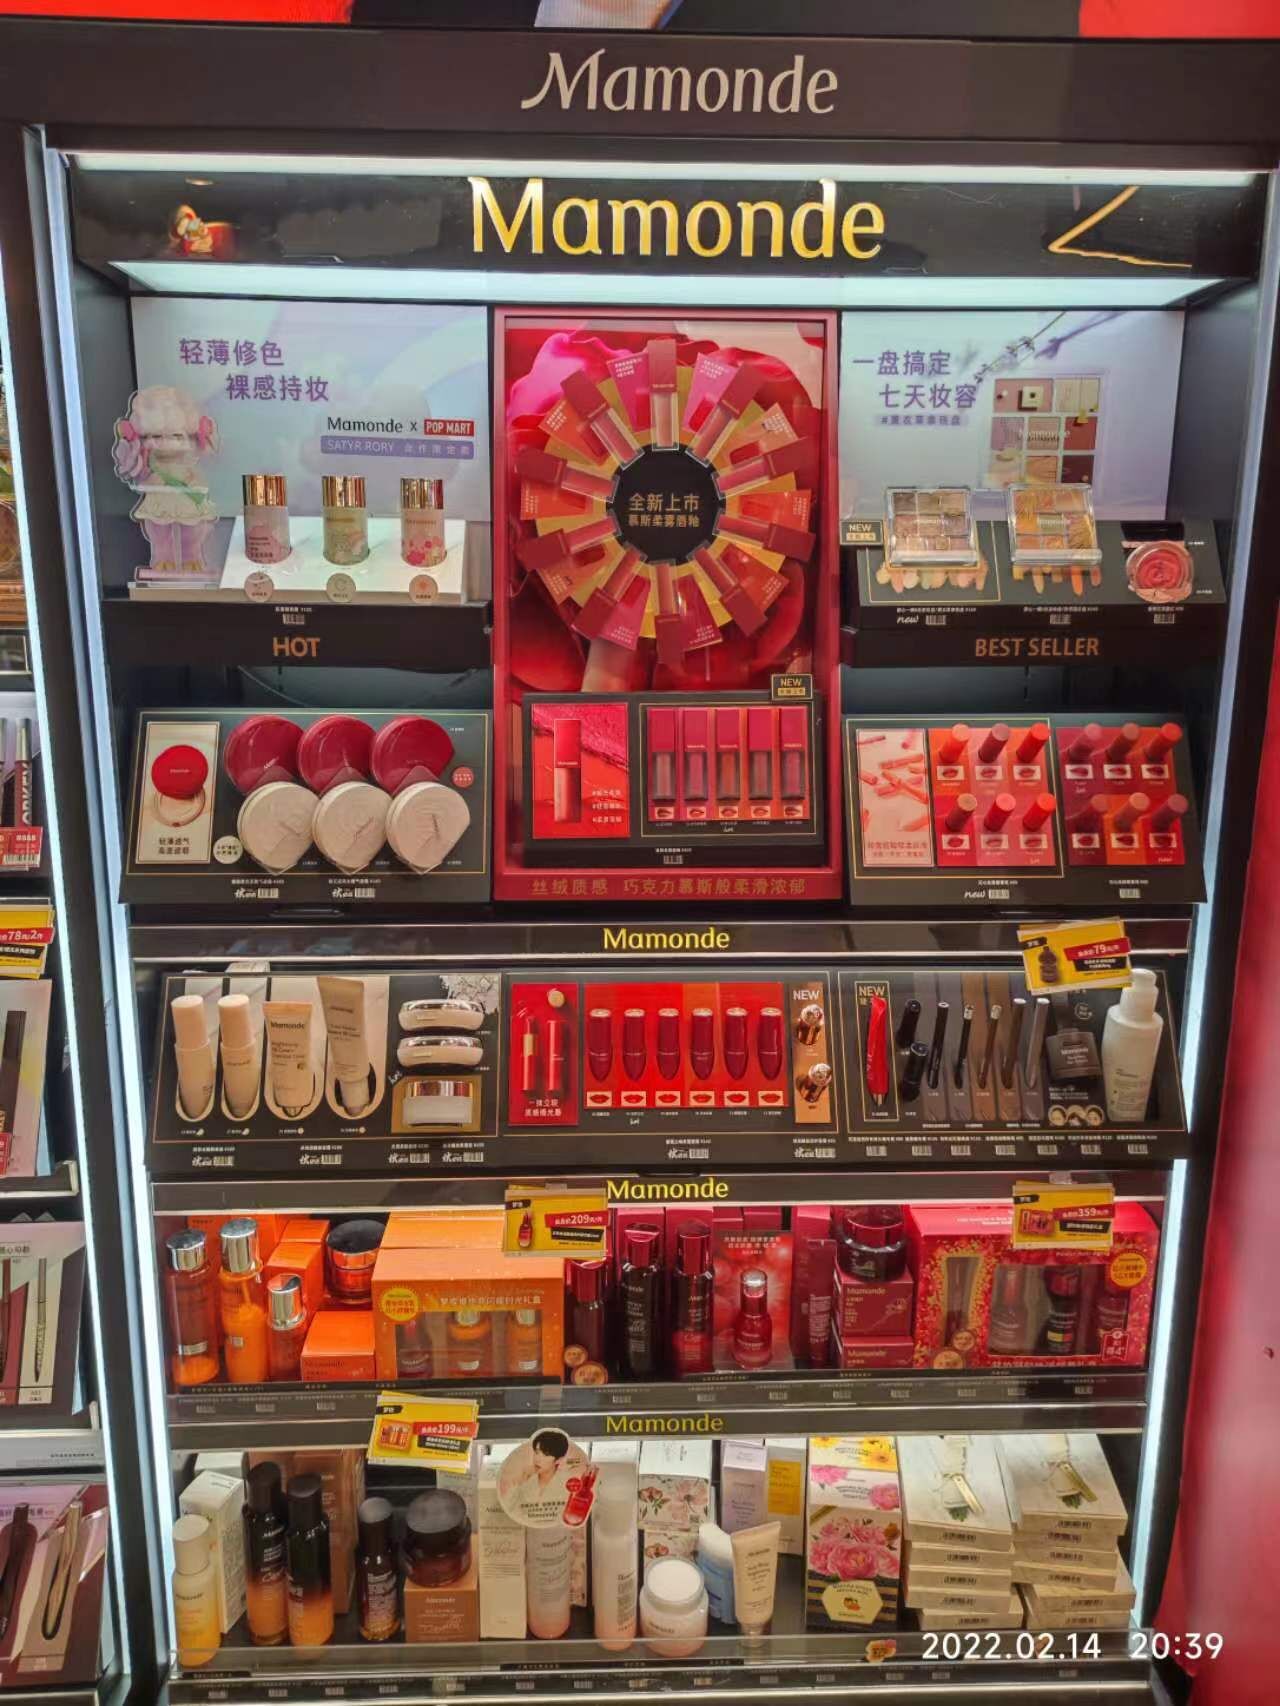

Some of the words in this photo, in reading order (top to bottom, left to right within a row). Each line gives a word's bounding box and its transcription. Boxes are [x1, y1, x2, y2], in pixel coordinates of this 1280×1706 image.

[521, 49, 838, 115] Mamonde
[468, 177, 885, 260] Mamonde
[179, 339, 284, 367] 轻薄修色
[853, 350, 951, 376] 一盘搞定
[226, 375, 329, 402] 裸感持妆
[879, 383, 977, 409] 七天妆容
[327, 417, 403, 433] Mamonde
[426, 422, 444, 434] POP
[446, 423, 471, 435] MART
[365, 442, 395, 453] RORY
[629, 493, 700, 512] 全新上市
[849, 523, 872, 533] NEW
[272, 637, 321, 657] HOT
[975, 638, 1024, 657] BEST
[1028, 638, 1100, 657] SELLER
[780, 678, 802, 687] NEW
[531, 877, 609, 896] 丝绒质感
[623, 877, 807, 896] 巧克力慕斯般柔滑浓郁
[963, 890, 986, 899] new
[603, 926, 730, 950] Mamonde
[793, 990, 820, 1001] NEW
[859, 986, 886, 997] NEW
[606, 1177, 729, 1200] Mamonde
[847, 1287, 886, 1296] Mamonde
[605, 1413, 724, 1434] Mamonde
